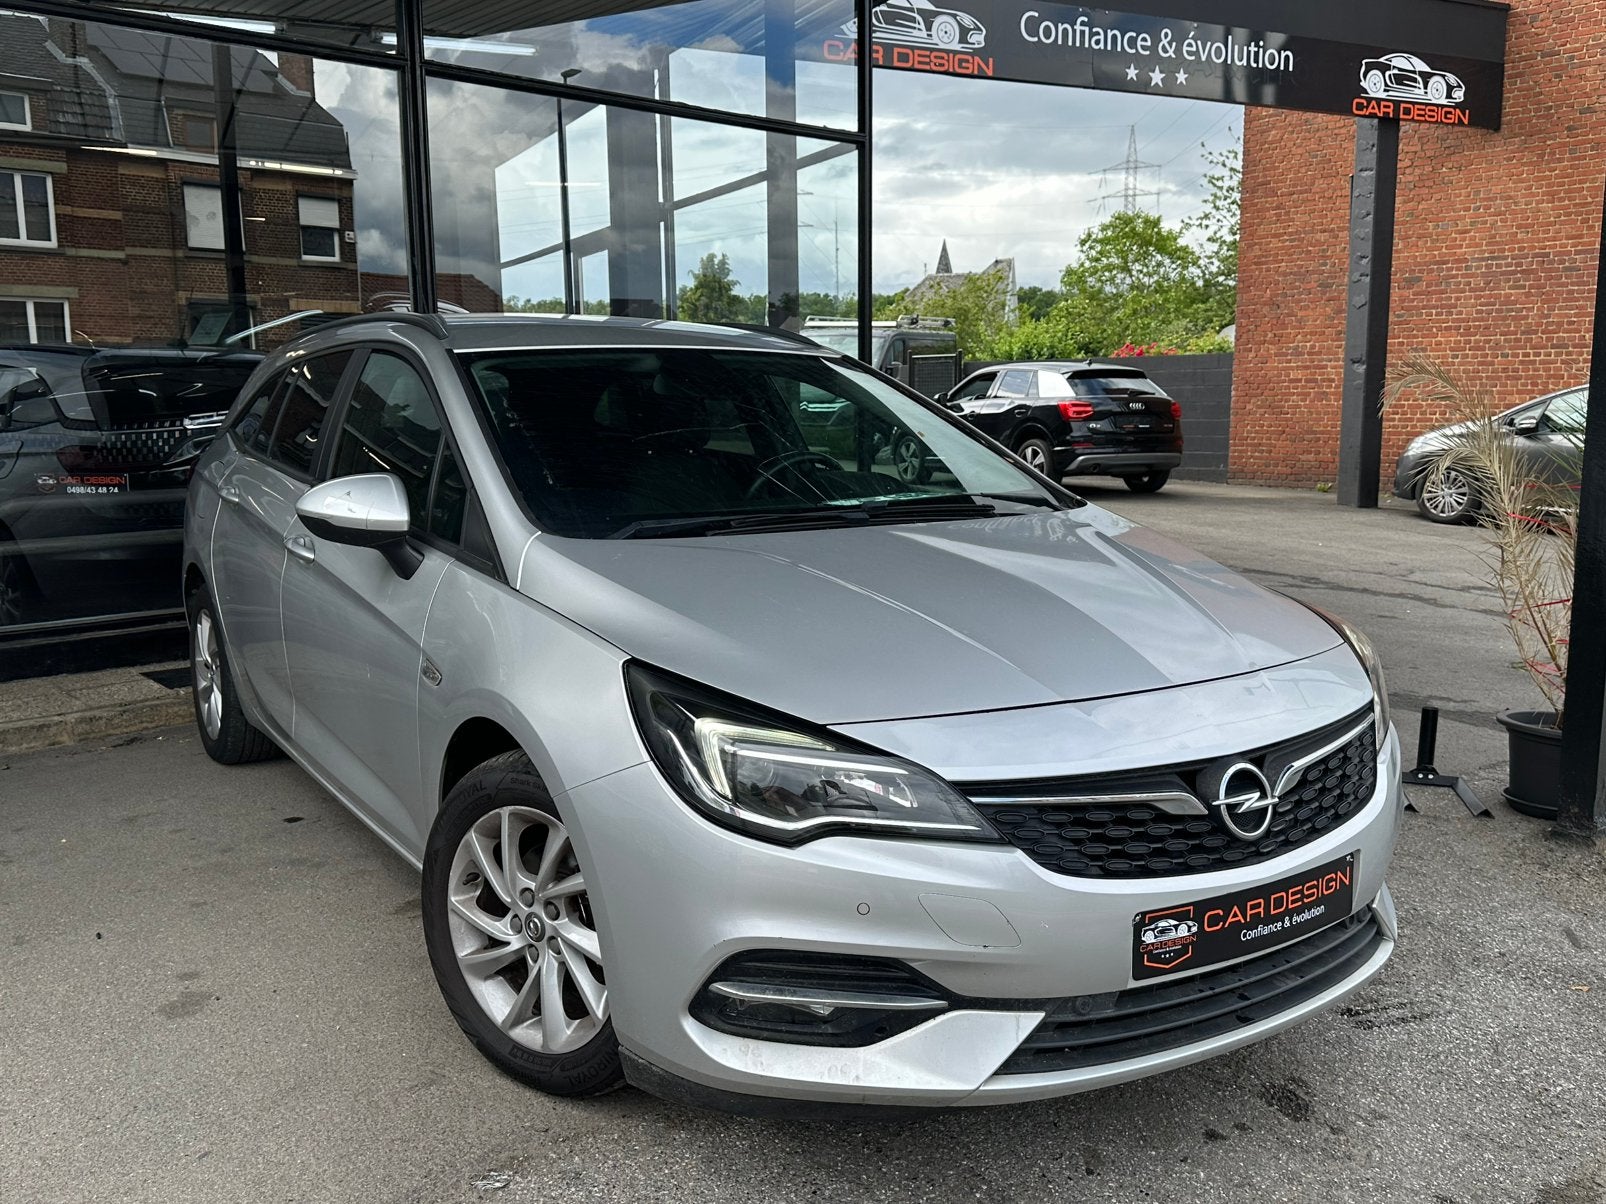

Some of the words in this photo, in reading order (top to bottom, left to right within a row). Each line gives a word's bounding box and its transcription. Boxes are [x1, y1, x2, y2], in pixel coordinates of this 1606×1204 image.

[1019, 11, 1152, 56] Confiance
[1158, 28, 1176, 58] &
[1182, 31, 1294, 72] évolution
[893, 47, 994, 76] DESIGN
[1352, 98, 1394, 118] CAR
[1400, 103, 1469, 125] DESIGN
[83, 476, 126, 485] DESIGN
[97, 486, 107, 494] 48
[1203, 898, 1264, 933] CAR
[1270, 866, 1350, 915] DESIGN
[1240, 922, 1283, 941] Confiance
[1283, 916, 1291, 929] &
[1291, 904, 1326, 925] évolution
[1140, 942, 1161, 953] CAR
[1162, 935, 1197, 948] DESIGN
